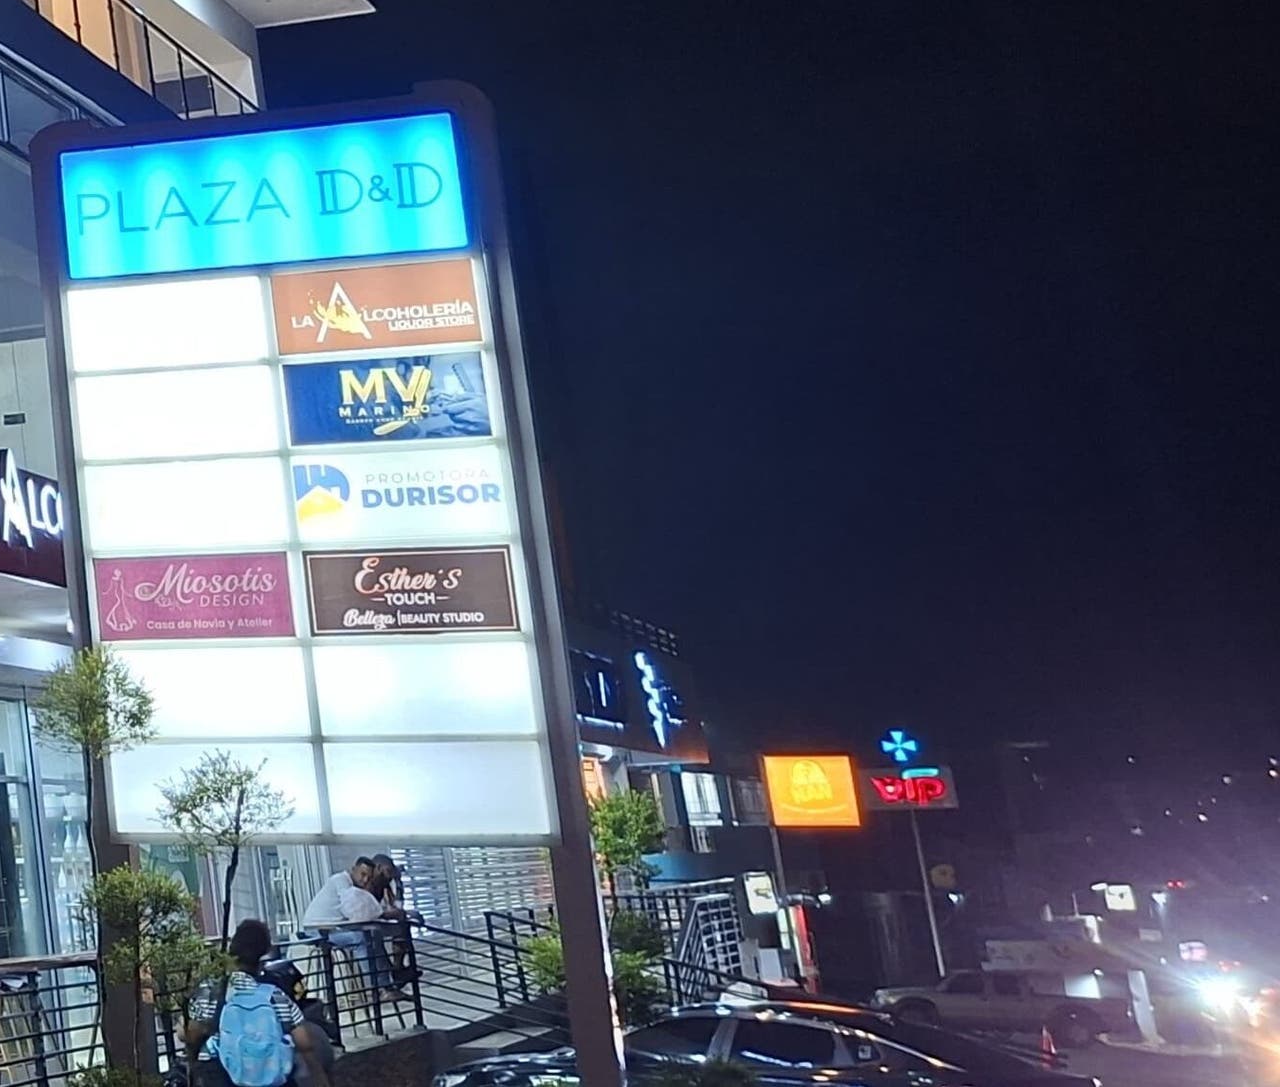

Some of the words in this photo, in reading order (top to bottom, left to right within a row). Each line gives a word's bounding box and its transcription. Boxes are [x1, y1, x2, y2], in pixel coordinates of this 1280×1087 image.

[75, 177, 290, 236] PLAZA
[291, 315, 315, 328] LA
[361, 483, 501, 509] DURISOR
[134, 563, 277, 604] Miosotis
[200, 593, 265, 608] DESIGN
[384, 593, 436, 606] TOUCH
[146, 620, 176, 630] Casa
[177, 619, 192, 629] de
[227, 618, 235, 630] y
[343, 609, 396, 631] Belleza
[401, 613, 440, 624] BEAUTY
[442, 612, 485, 623] STUDIO
